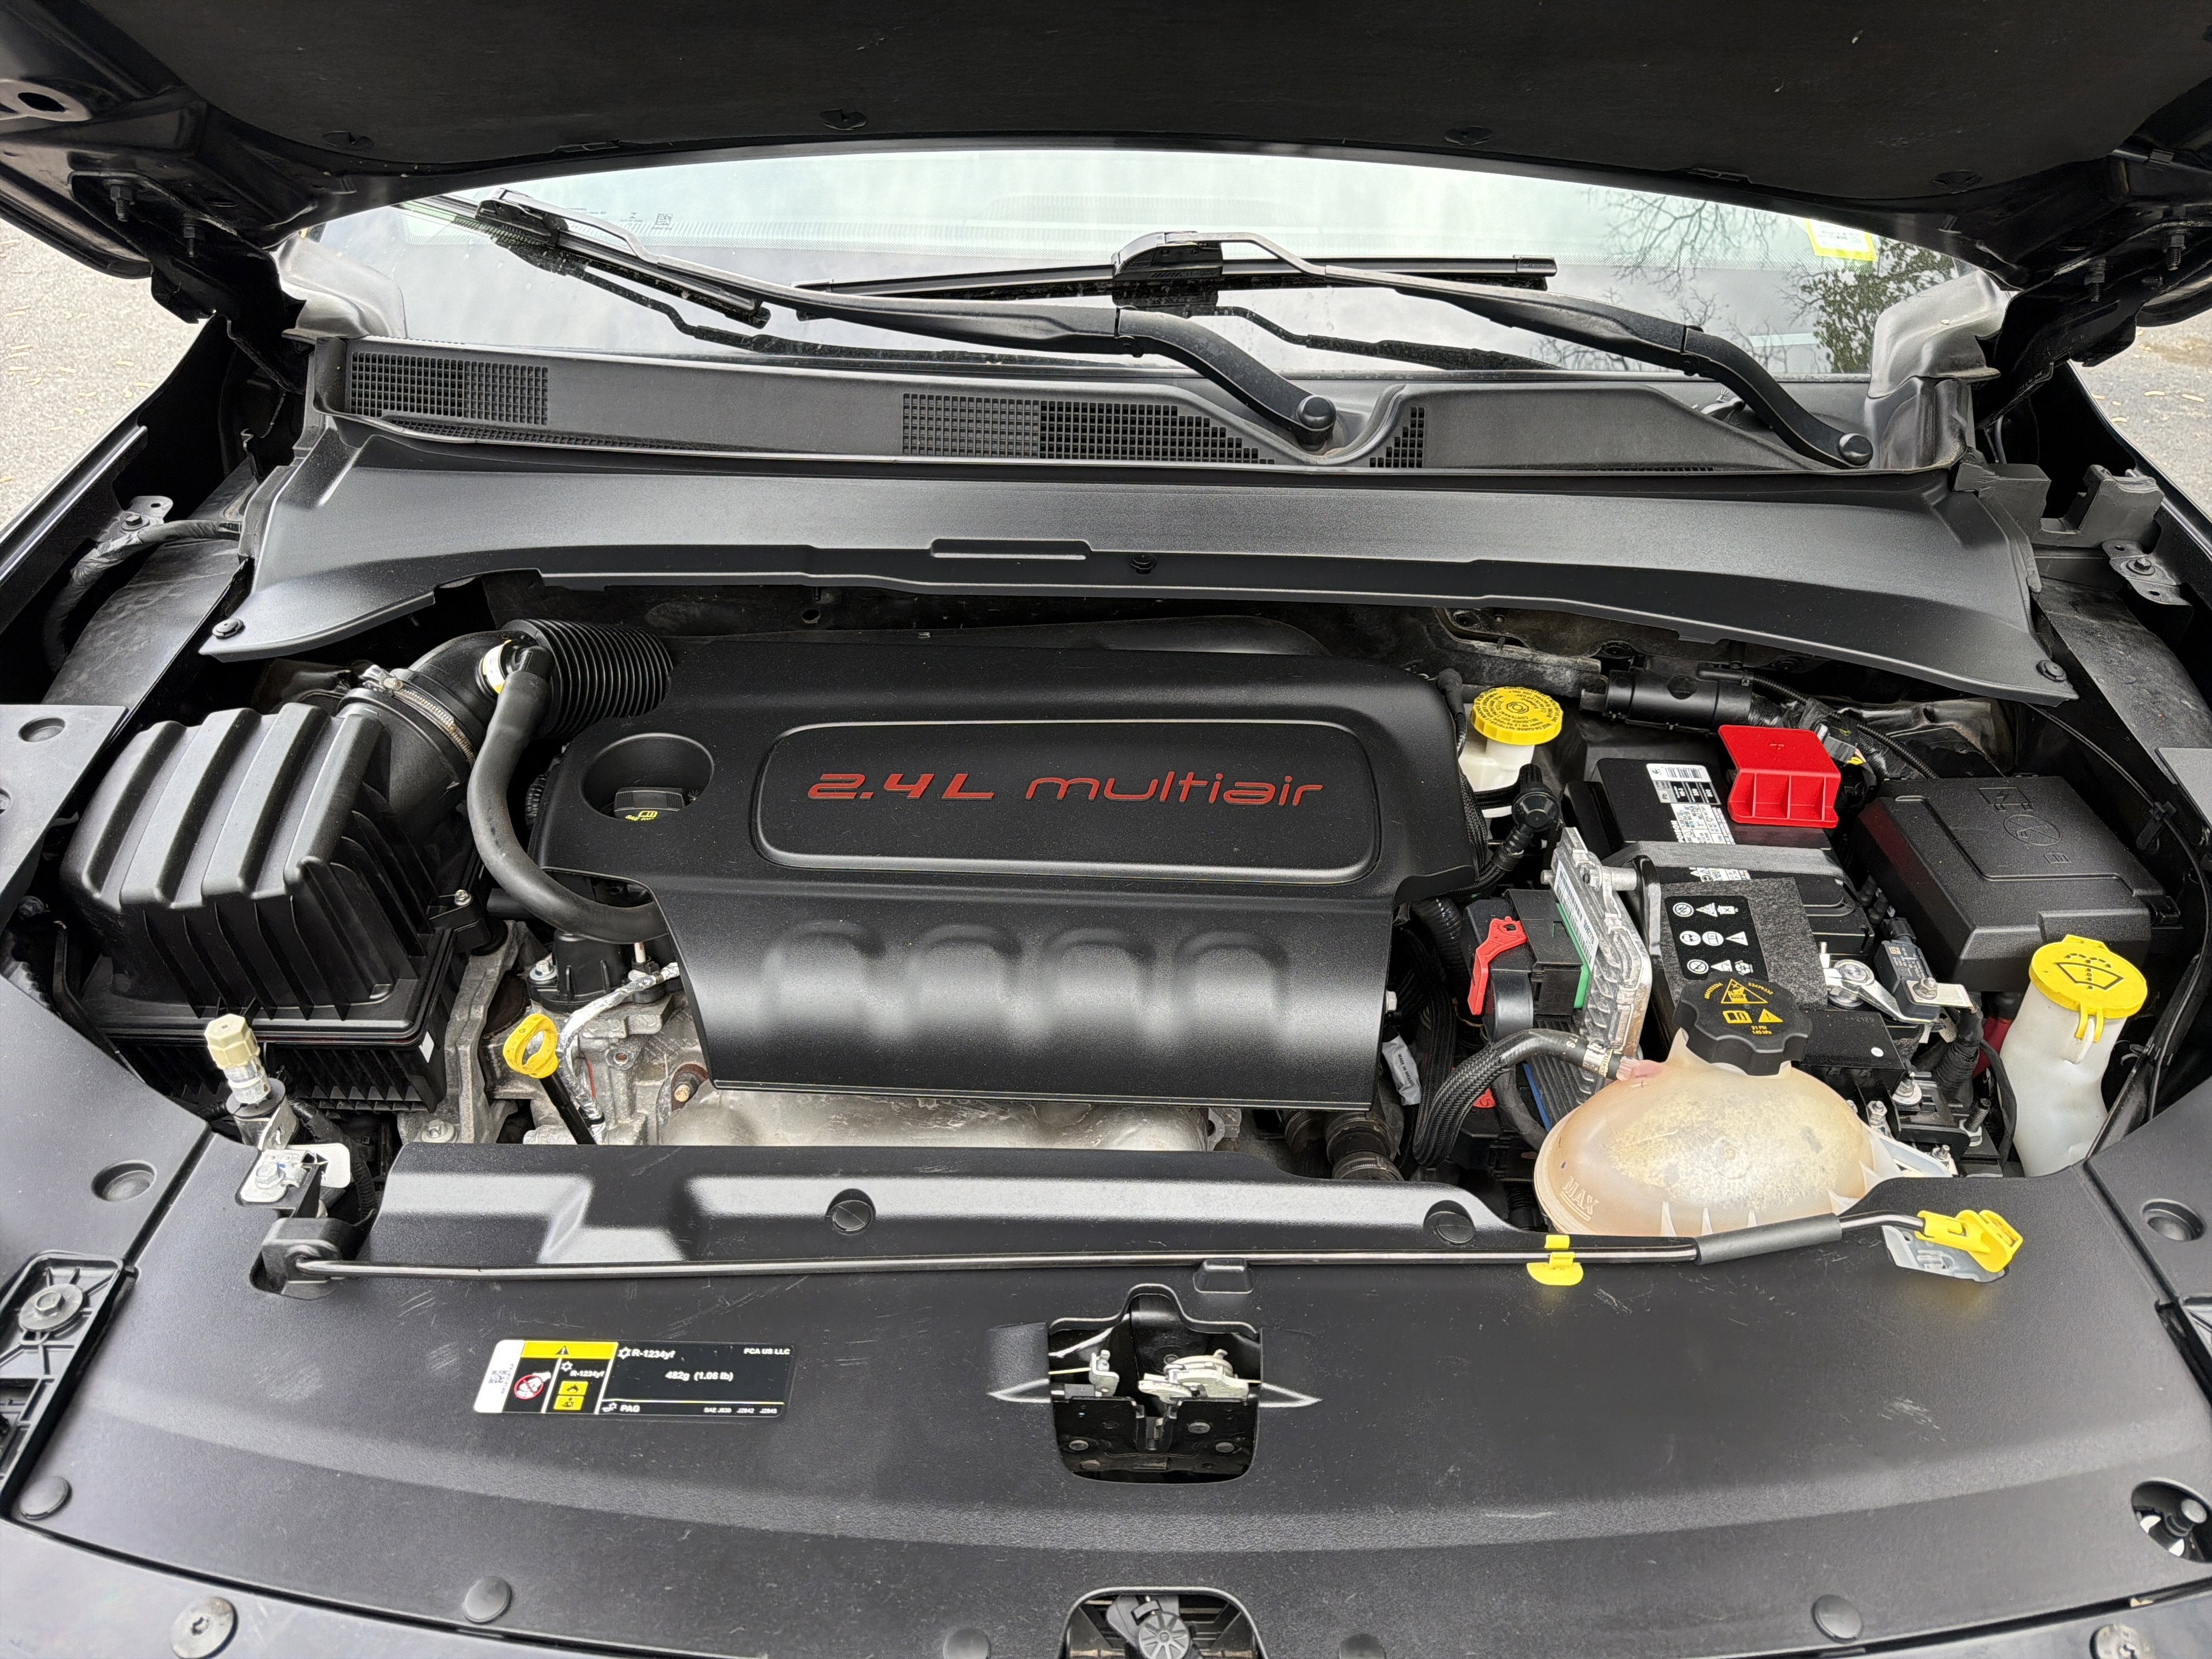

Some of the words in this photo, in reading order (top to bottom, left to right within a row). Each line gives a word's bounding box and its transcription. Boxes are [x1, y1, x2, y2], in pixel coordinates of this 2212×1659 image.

[1026, 771, 1323, 806] multiair
[1671, 820, 1685, 843] POISON
[1405, 1071, 1415, 1086] MEXICO
[1562, 1176, 1599, 1215] MAX
[631, 1348, 676, 1360] R-1234yf
[665, 1371, 690, 1381] 482g
[693, 1371, 719, 1381] (1.06
[719, 1372, 734, 1382] lb)
[619, 1404, 640, 1413] PAG
